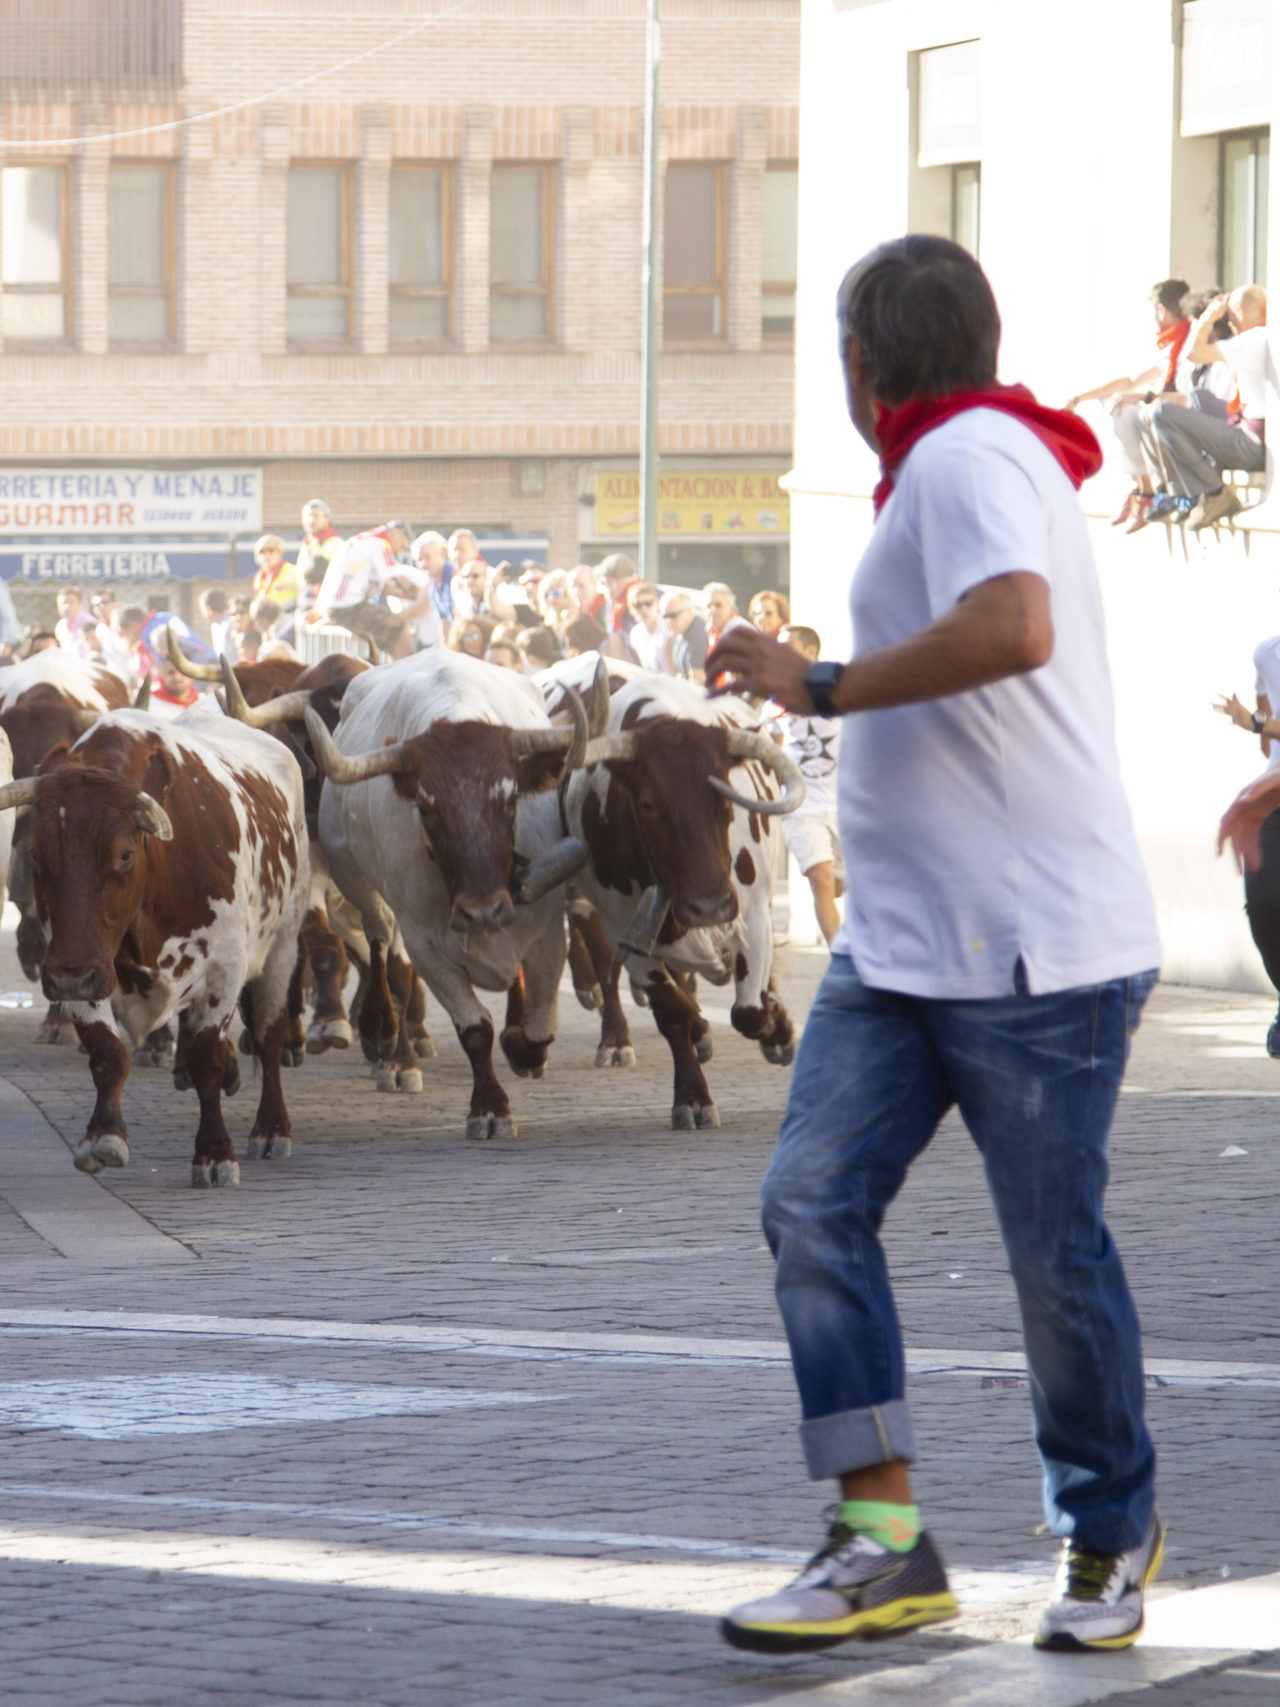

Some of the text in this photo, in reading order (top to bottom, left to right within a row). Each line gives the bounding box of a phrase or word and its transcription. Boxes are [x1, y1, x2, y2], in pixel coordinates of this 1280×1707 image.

[124, 474, 142, 497] Y
[152, 474, 256, 497] MENAJE
[605, 476, 737, 499] ALIMNTACION
[21, 553, 171, 577] FERRETERIA
